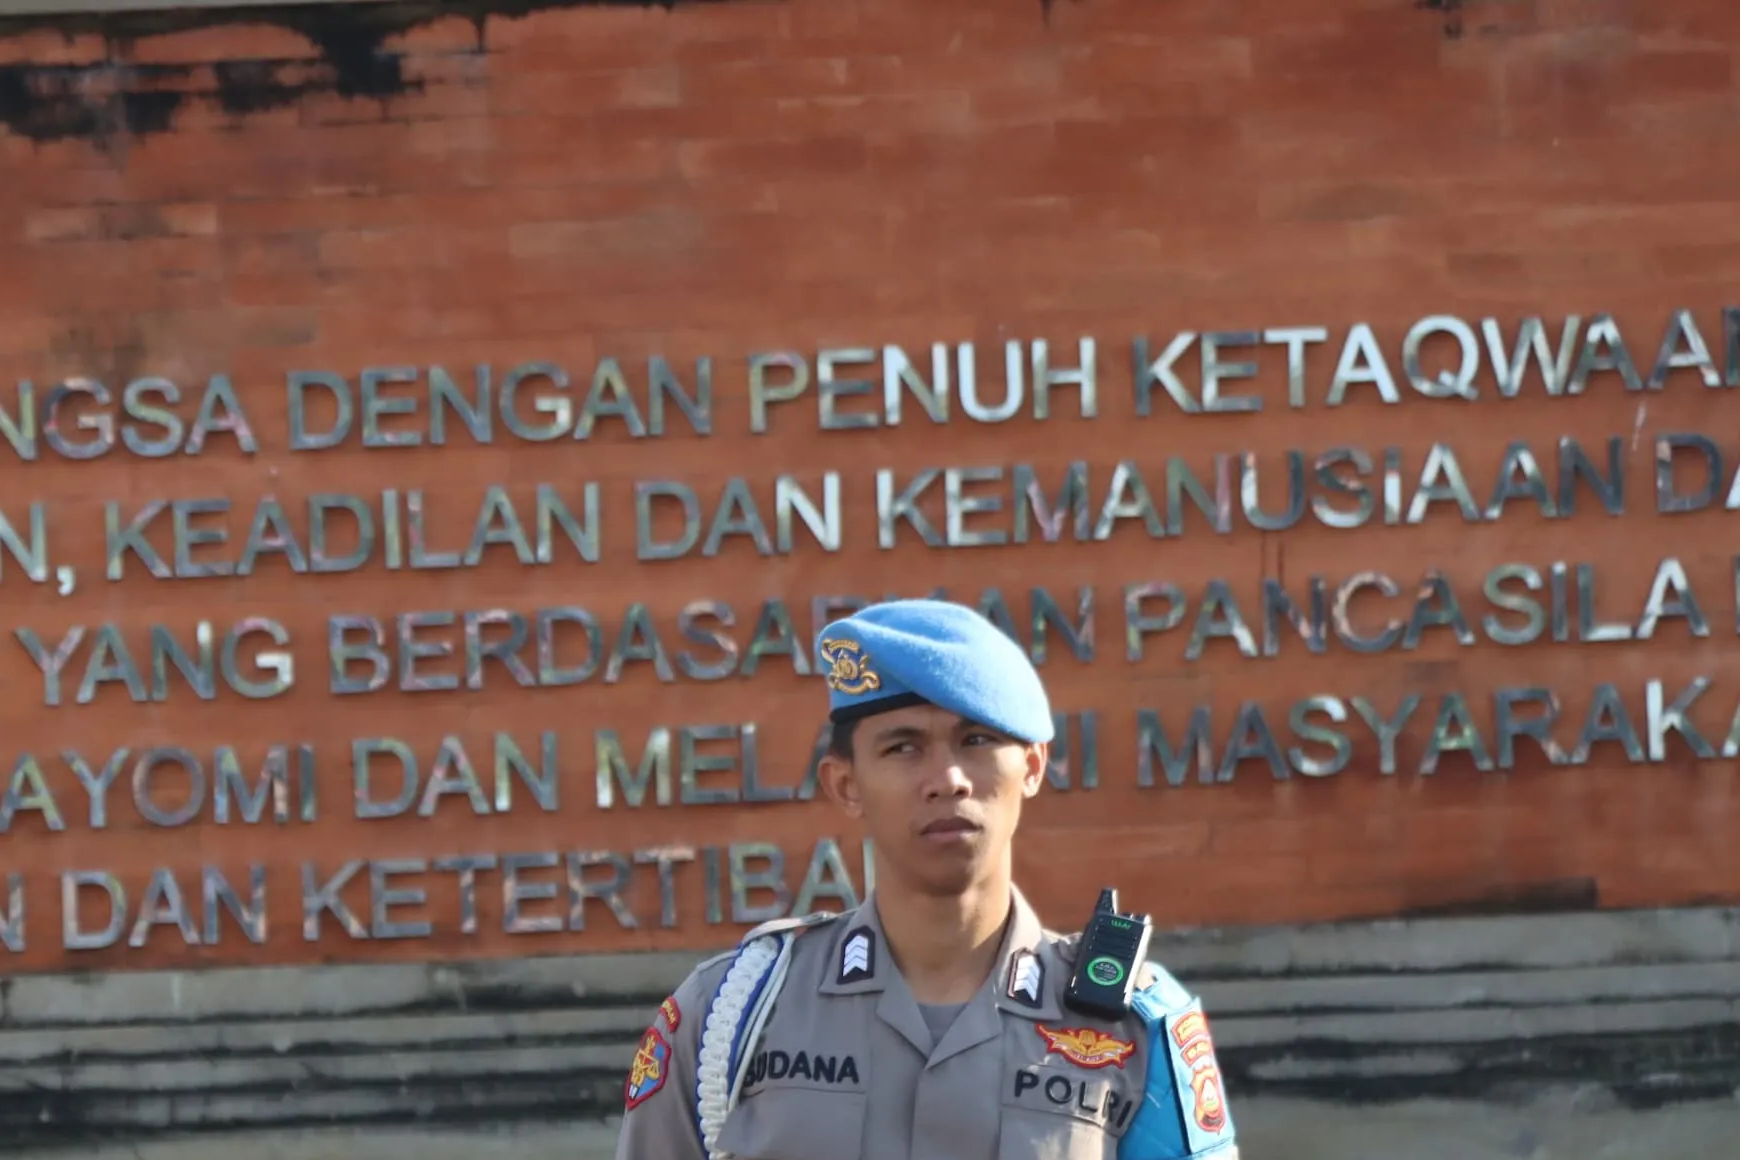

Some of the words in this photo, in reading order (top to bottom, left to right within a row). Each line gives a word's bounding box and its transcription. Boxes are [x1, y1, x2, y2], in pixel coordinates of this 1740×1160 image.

[288, 354, 713, 452] DENGAN
[748, 336, 1097, 434] PENUH
[106, 482, 601, 580] KEADILAN
[636, 471, 842, 562] DAN
[876, 435, 1625, 550] KEMANUSIAAN
[16, 617, 294, 707] YANG
[1126, 557, 1709, 663] PANCASILA
[353, 731, 558, 819] DAN
[1137, 676, 1740, 788] MASYARAK
[63, 864, 267, 951] DAN
[302, 837, 875, 943] KETERTIBA
[1014, 1069, 1133, 1129] POLRI
